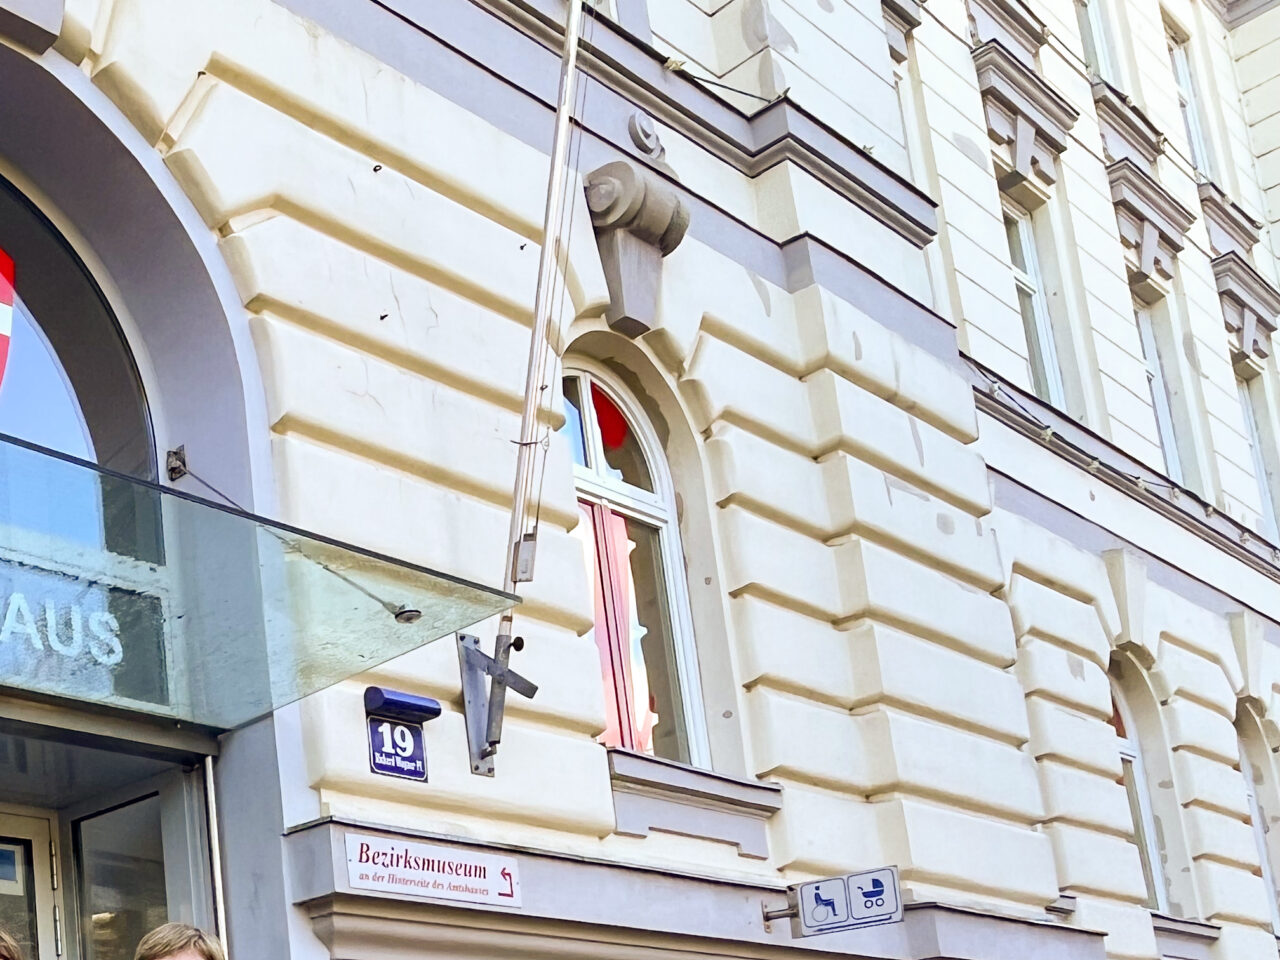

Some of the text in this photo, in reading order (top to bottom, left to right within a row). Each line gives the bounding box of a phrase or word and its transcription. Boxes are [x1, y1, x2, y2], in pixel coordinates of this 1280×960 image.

[377, 722, 415, 758] 19
[358, 842, 487, 880] Bezirksmuseum
[359, 872, 489, 896] an der Hinterseite des Amtshauses
